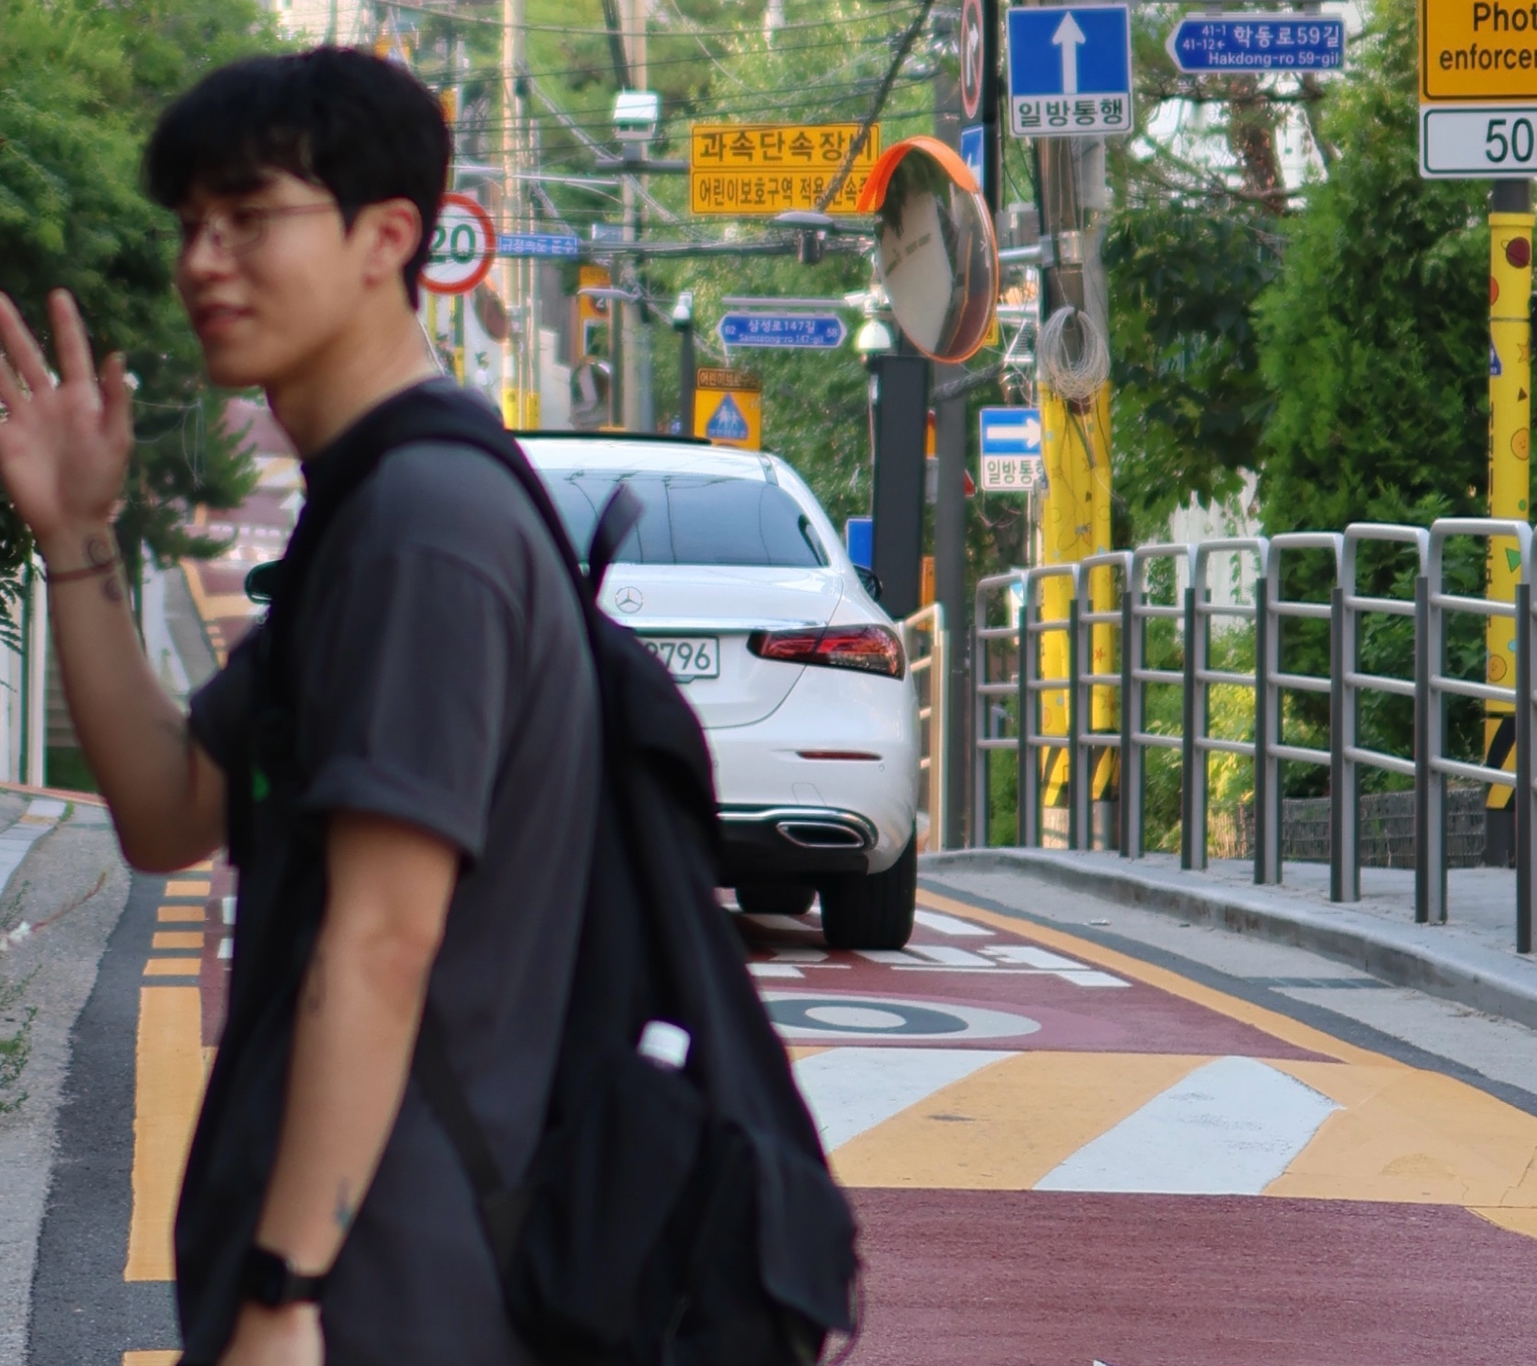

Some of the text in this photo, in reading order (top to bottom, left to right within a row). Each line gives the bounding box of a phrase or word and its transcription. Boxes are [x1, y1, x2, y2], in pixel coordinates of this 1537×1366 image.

[1201, 25, 1227, 37] 41-1
[1233, 25, 1340, 49] 학동로59길
[1182, 39, 1216, 51] 41-12
[1208, 51, 1340, 68] Hakdong-ro 59-gil
[1018, 98, 1123, 128] 일방통행
[699, 176, 794, 207] 어린이보호구역
[430, 223, 477, 265] 20
[748, 319, 816, 334] 삼성로147길
